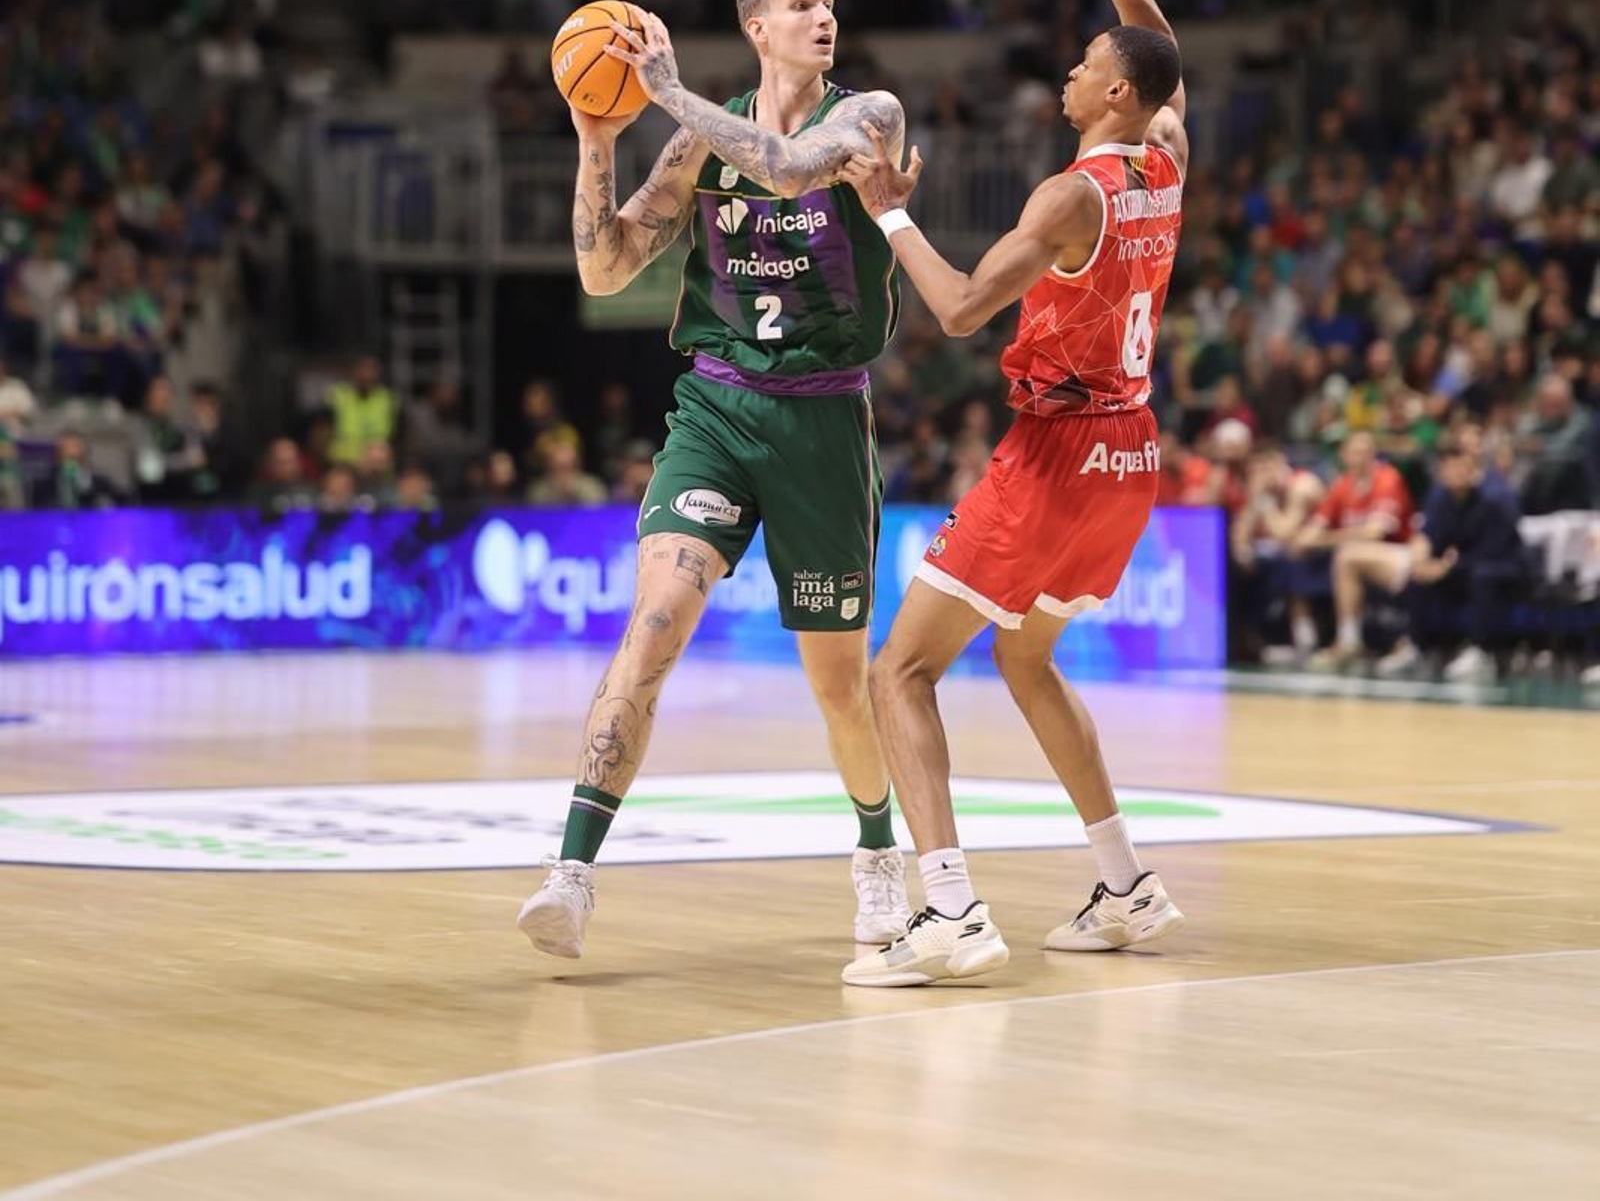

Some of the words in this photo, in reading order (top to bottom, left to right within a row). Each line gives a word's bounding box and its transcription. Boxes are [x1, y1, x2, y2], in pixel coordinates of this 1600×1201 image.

[754, 295, 783, 340] 2
[0, 543, 373, 627] uirónsalud
[793, 588, 835, 613] laga
[800, 575, 836, 594] má
